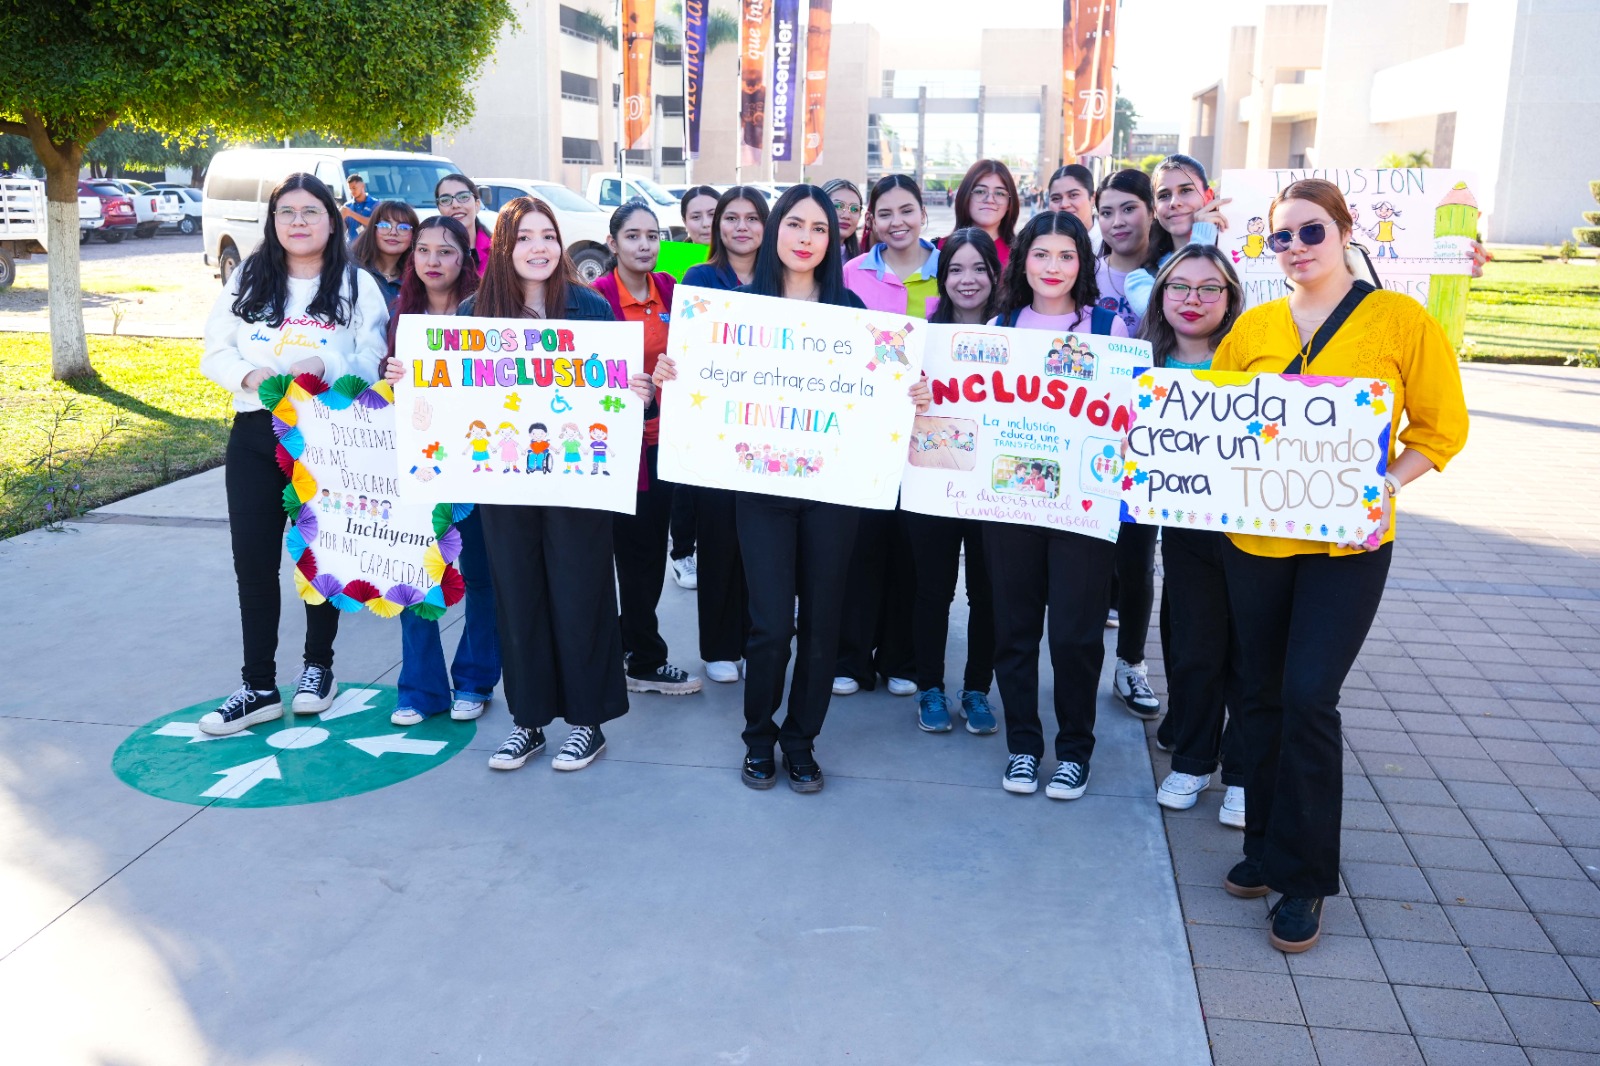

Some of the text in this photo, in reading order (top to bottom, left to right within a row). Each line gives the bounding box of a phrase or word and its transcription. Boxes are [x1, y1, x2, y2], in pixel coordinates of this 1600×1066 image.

[748, 28, 764, 60] que
[771, 20, 792, 140] Trascender
[250, 329, 270, 341] du
[426, 328, 575, 352] UNIDOS POR
[708, 321, 852, 356] INCLUIR no es
[1108, 342, 1150, 359] 03/12/25
[413, 353, 629, 389] LA INCLUSIÓN
[699, 360, 748, 388] dejar
[830, 374, 856, 395] dar
[859, 377, 874, 398] la
[921, 369, 1129, 435] NCLUSIÓN
[1160, 378, 1336, 427] Ayuda a
[724, 400, 841, 436] BIENVENIDA
[982, 413, 1056, 433] La inclusión
[331, 422, 396, 451] DISCRIMI
[993, 438, 1059, 453] TRANSFORMA
[1000, 428, 1071, 451] educa, une y
[1217, 434, 1260, 461] un
[1275, 429, 1375, 463] mundo
[305, 442, 348, 468] POR MI
[976, 488, 1072, 511] diversidad
[1148, 467, 1361, 512] para TODOS
[319, 529, 358, 557] POR MI
[345, 517, 435, 548] Inclúyeme
